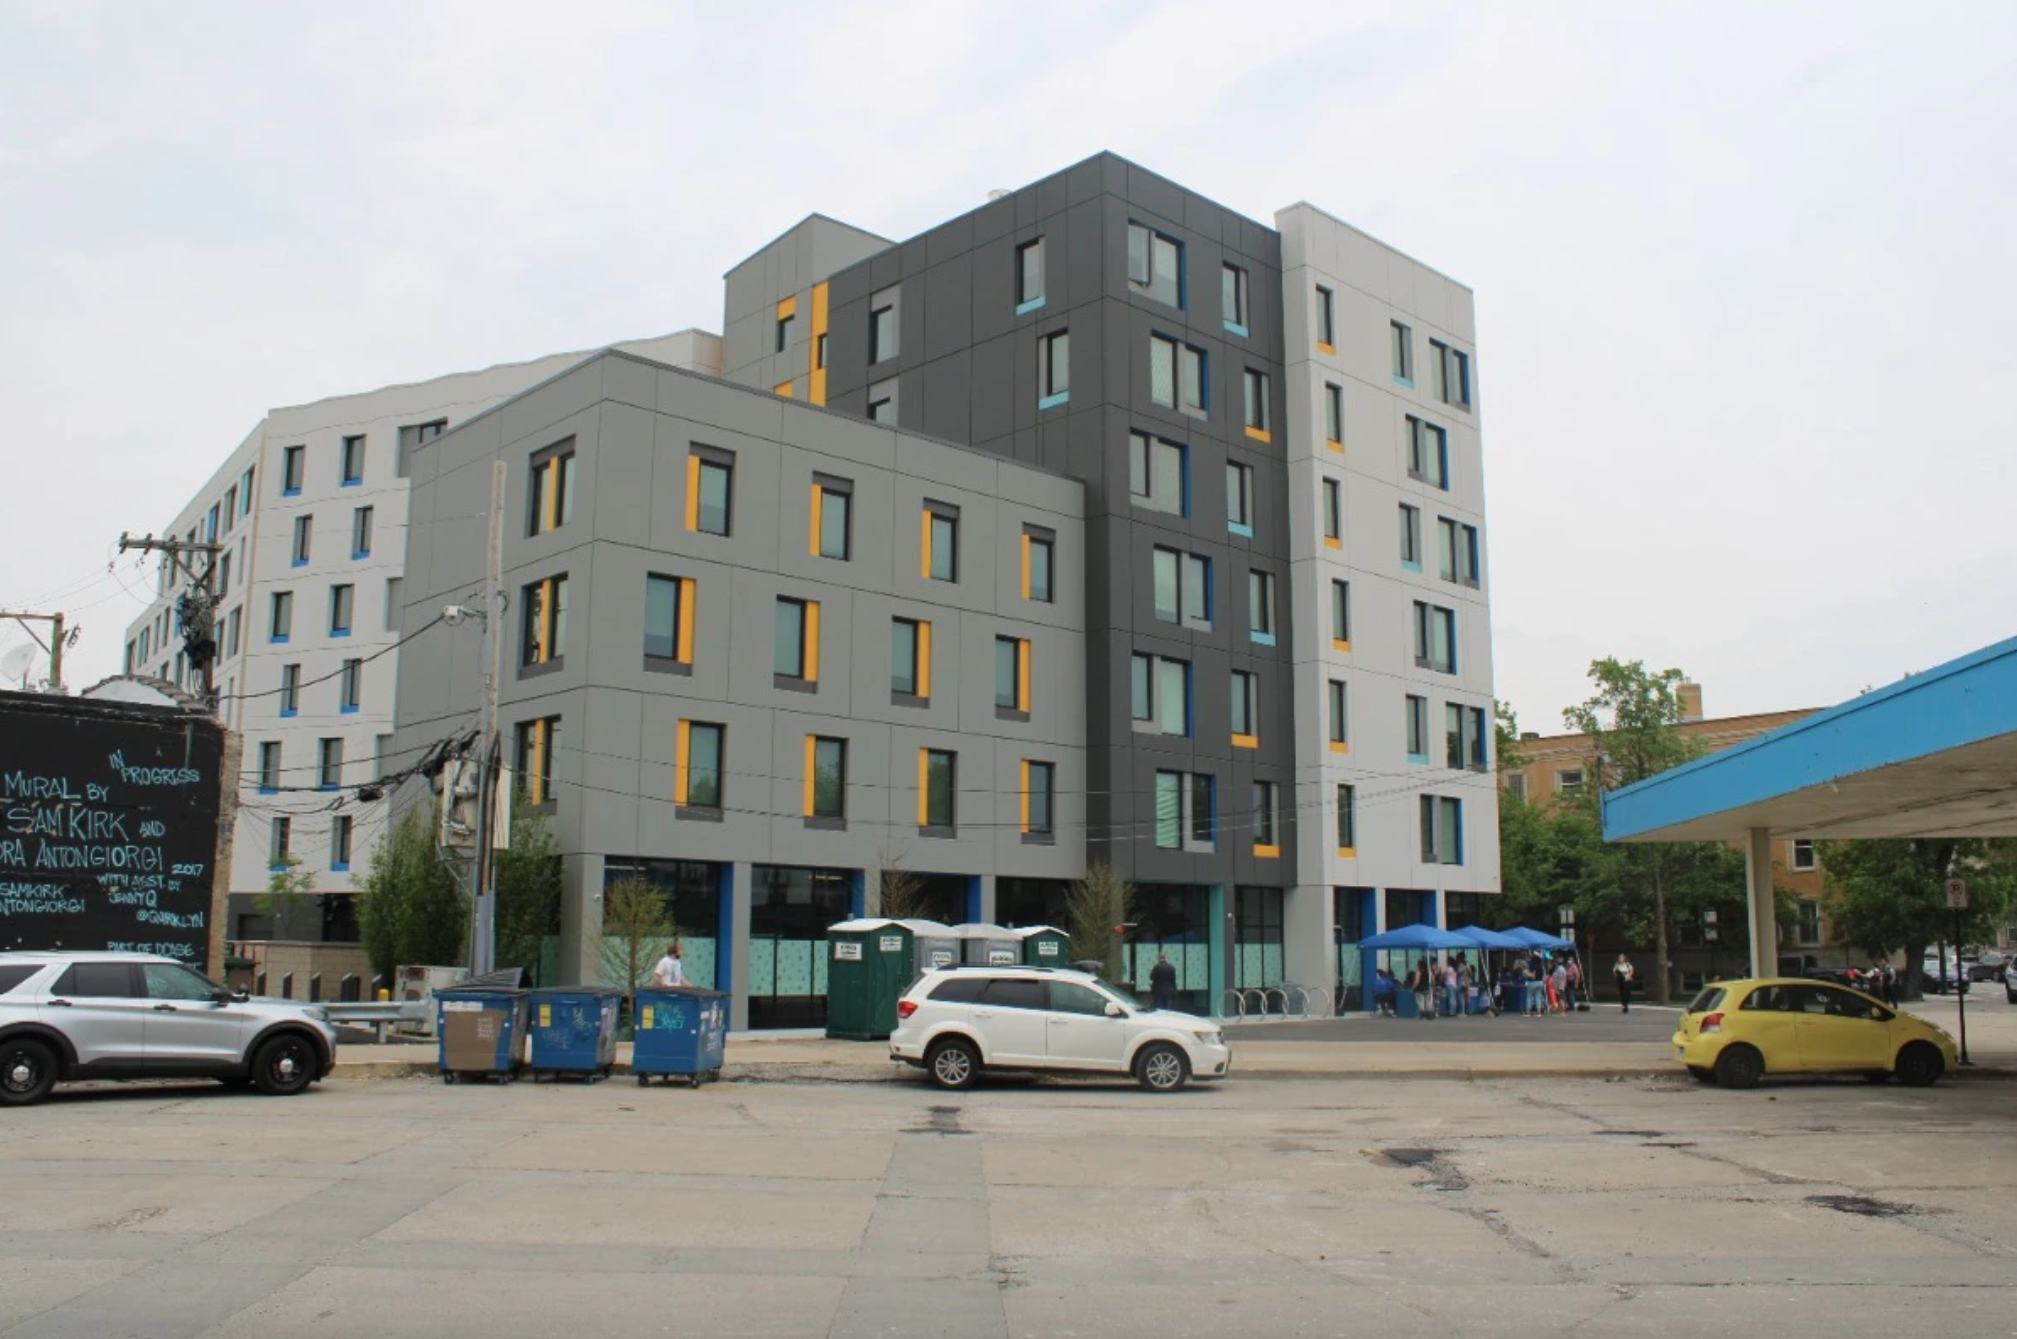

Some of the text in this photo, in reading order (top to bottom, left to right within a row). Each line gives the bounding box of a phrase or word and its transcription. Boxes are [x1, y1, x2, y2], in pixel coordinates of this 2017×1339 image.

[108, 748, 125, 770] IN
[4, 770, 109, 802] MURAL BY
[121, 765, 200, 786] PROGRESS
[7, 806, 166, 842] SAM KIRK AND
[35, 838, 163, 871] ANTONGIORGI
[171, 863, 204, 876] 2017
[97, 872, 129, 887] WITH
[167, 880, 182, 892] BY
